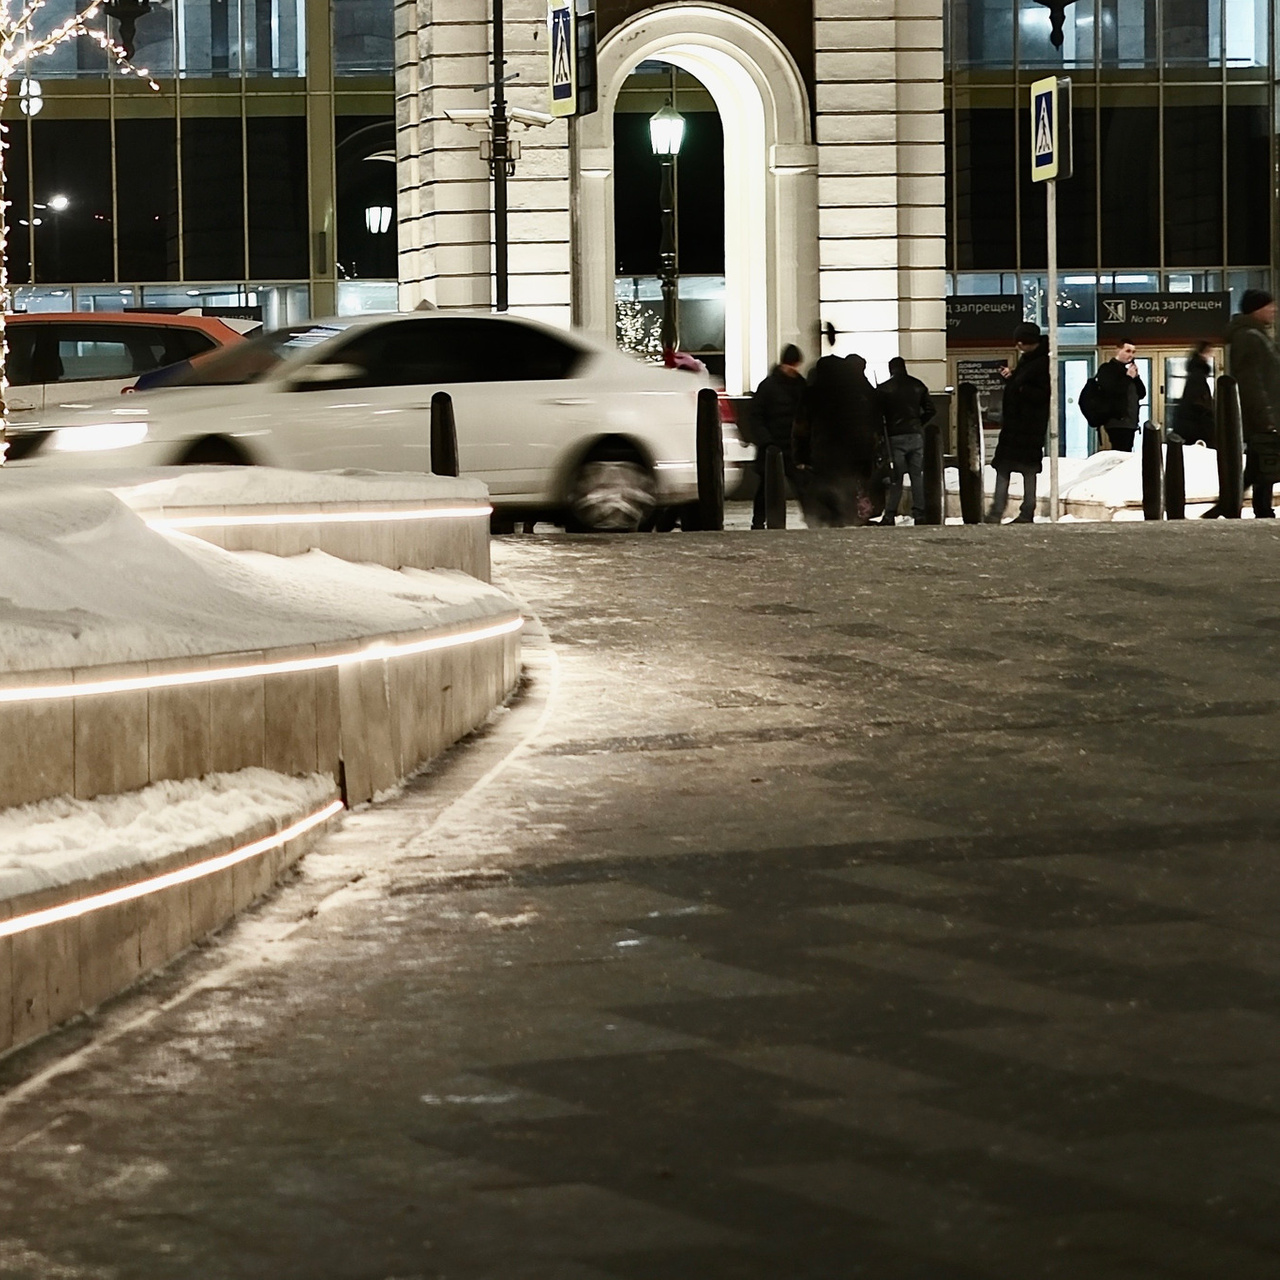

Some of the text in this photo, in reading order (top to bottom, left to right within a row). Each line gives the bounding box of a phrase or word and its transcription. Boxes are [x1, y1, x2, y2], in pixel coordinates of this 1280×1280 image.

[955, 303, 1016, 315] запрещен
[1130, 300, 1223, 312] Вход запрещен
[1130, 315, 1169, 324] No entry
